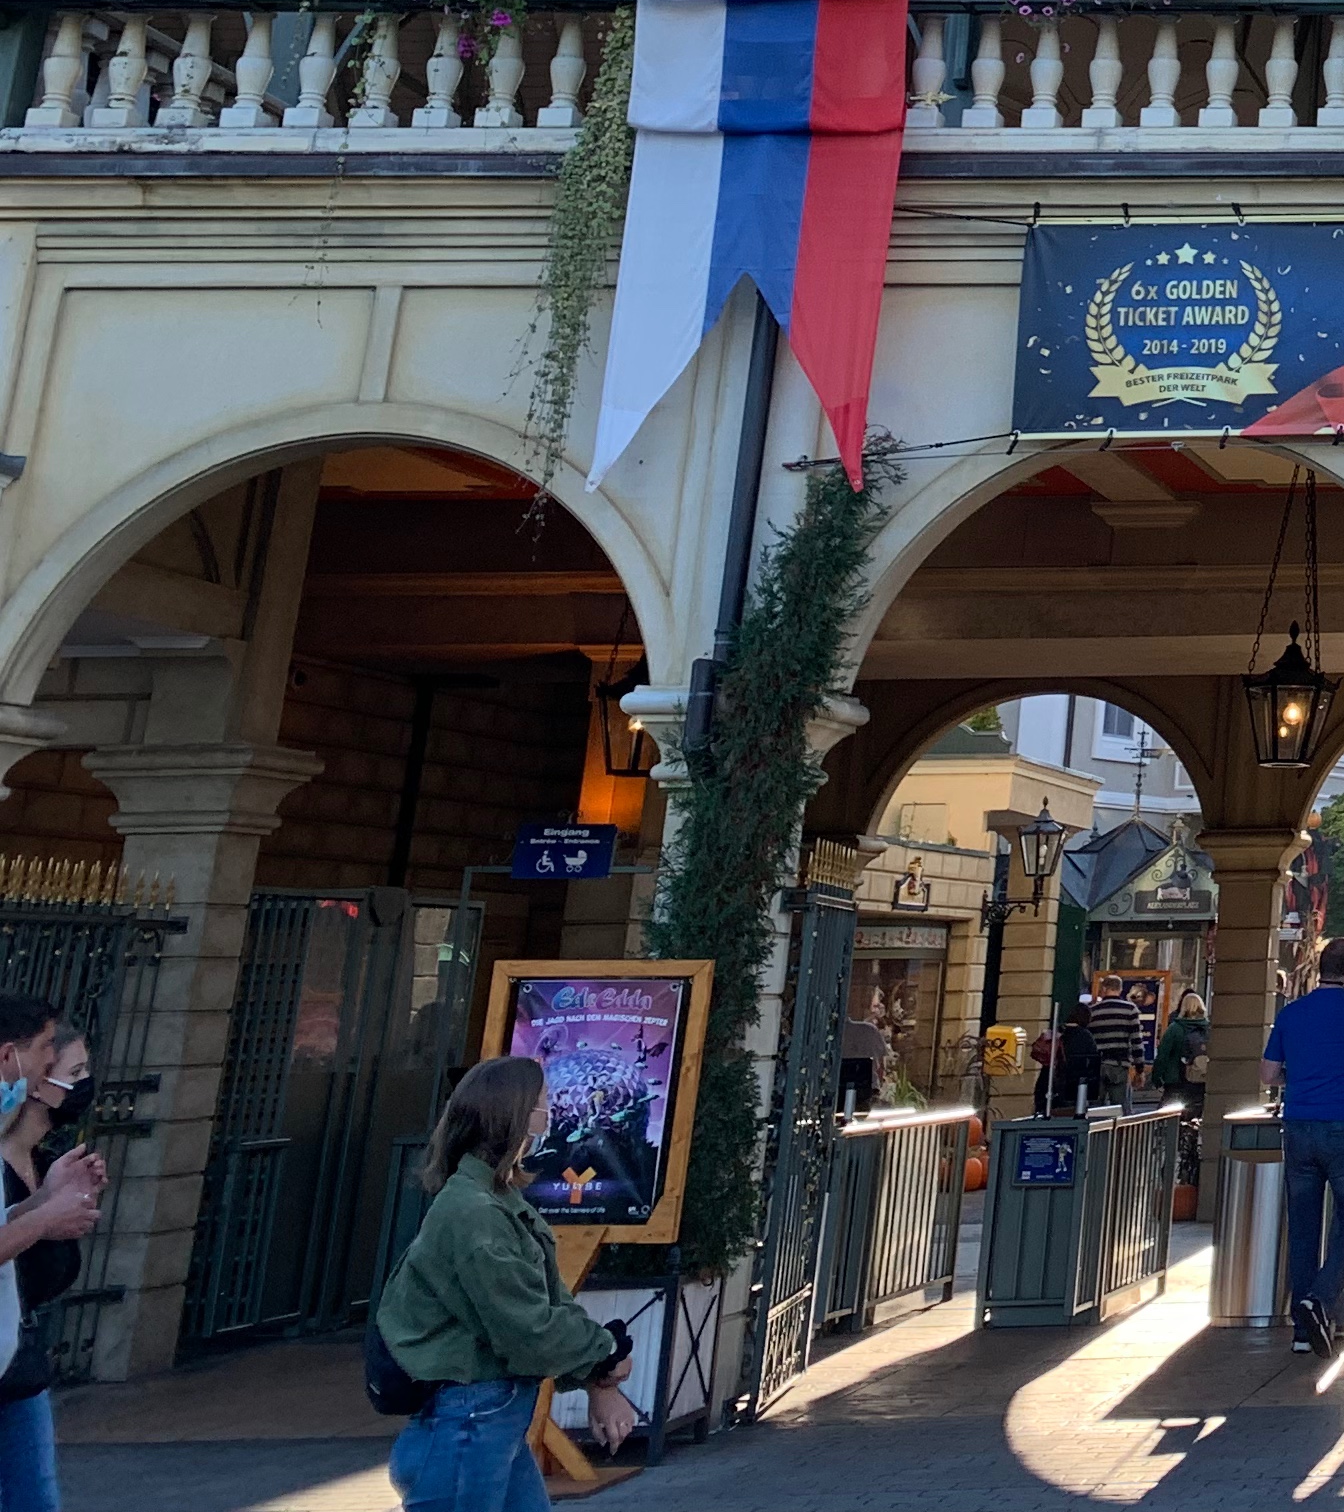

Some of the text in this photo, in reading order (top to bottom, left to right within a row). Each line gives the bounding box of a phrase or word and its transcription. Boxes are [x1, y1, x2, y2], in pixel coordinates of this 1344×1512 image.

[1165, 279, 1239, 300] GOLDEN
[1117, 305, 1250, 327] TICKET AWARD
[1142, 339, 1178, 355] 2014
[1189, 339, 1227, 354] 2019
[1125, 372, 1239, 388] BESTER FREIZEITPARK
[1158, 383, 1207, 394] DER WELT
[543, 828, 590, 838] Eingang
